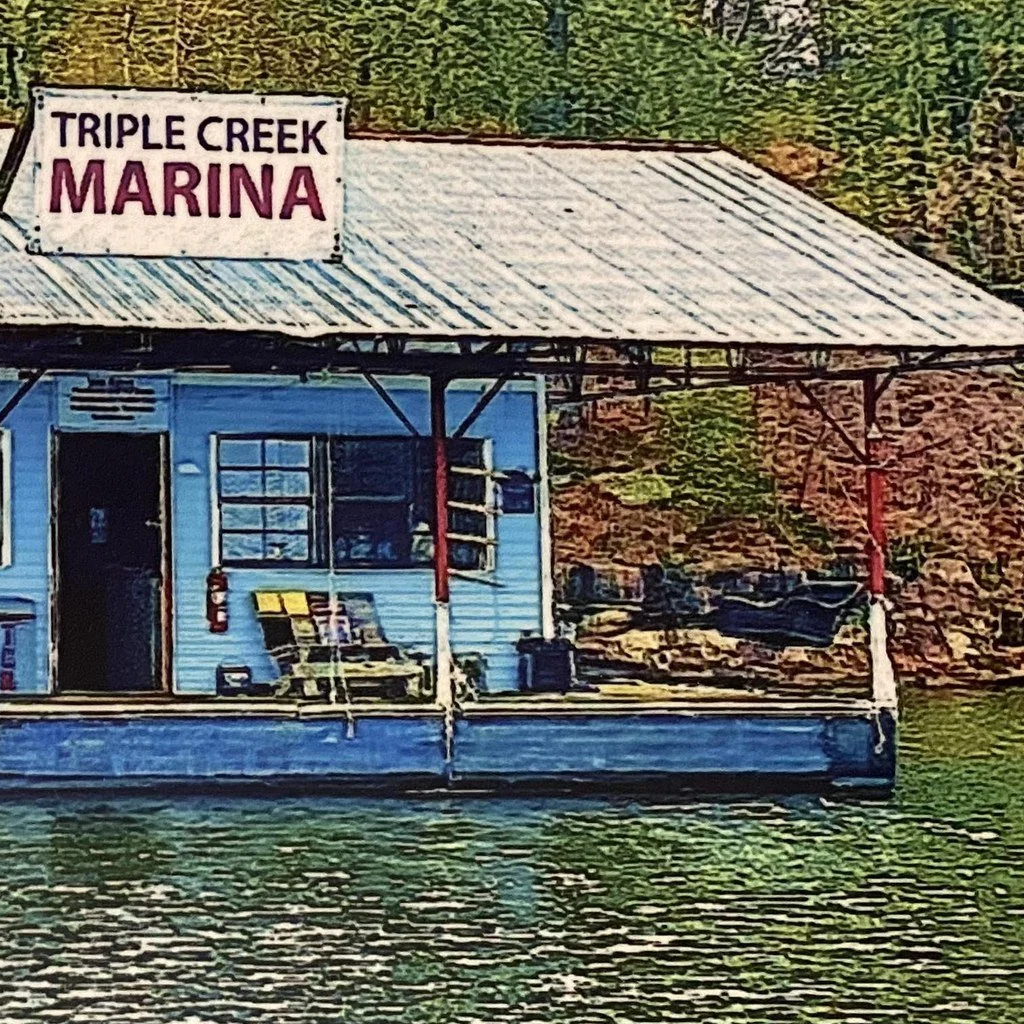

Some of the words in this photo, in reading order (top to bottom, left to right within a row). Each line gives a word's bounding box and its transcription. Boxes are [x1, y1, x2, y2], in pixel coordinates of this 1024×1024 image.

[51, 111, 186, 151] TRIPLE
[196, 116, 329, 155] CREEK
[49, 158, 327, 222] MARINA
